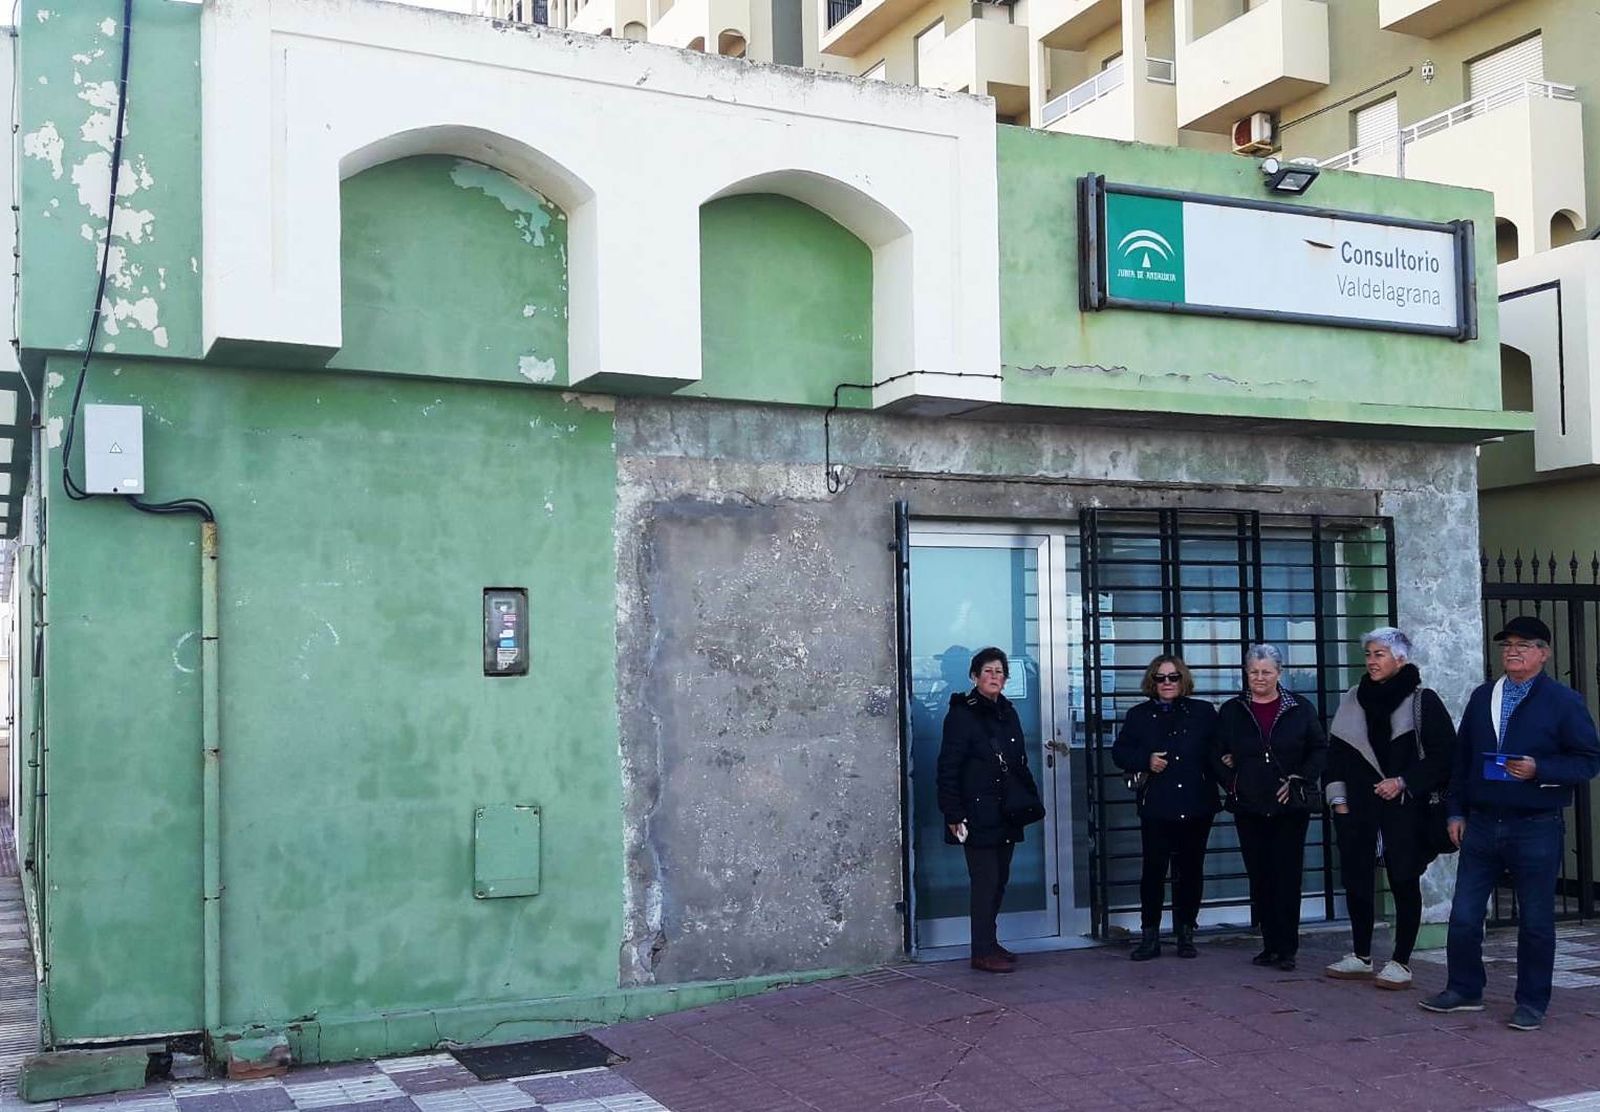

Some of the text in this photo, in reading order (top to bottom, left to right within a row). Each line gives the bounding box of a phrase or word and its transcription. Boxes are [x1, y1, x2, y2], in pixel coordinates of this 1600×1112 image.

[1341, 240, 1440, 273] Consultorio
[1117, 268, 1136, 278] JUNTA
[1136, 270, 1145, 279] DE
[1336, 273, 1441, 307] Valdelagrana
